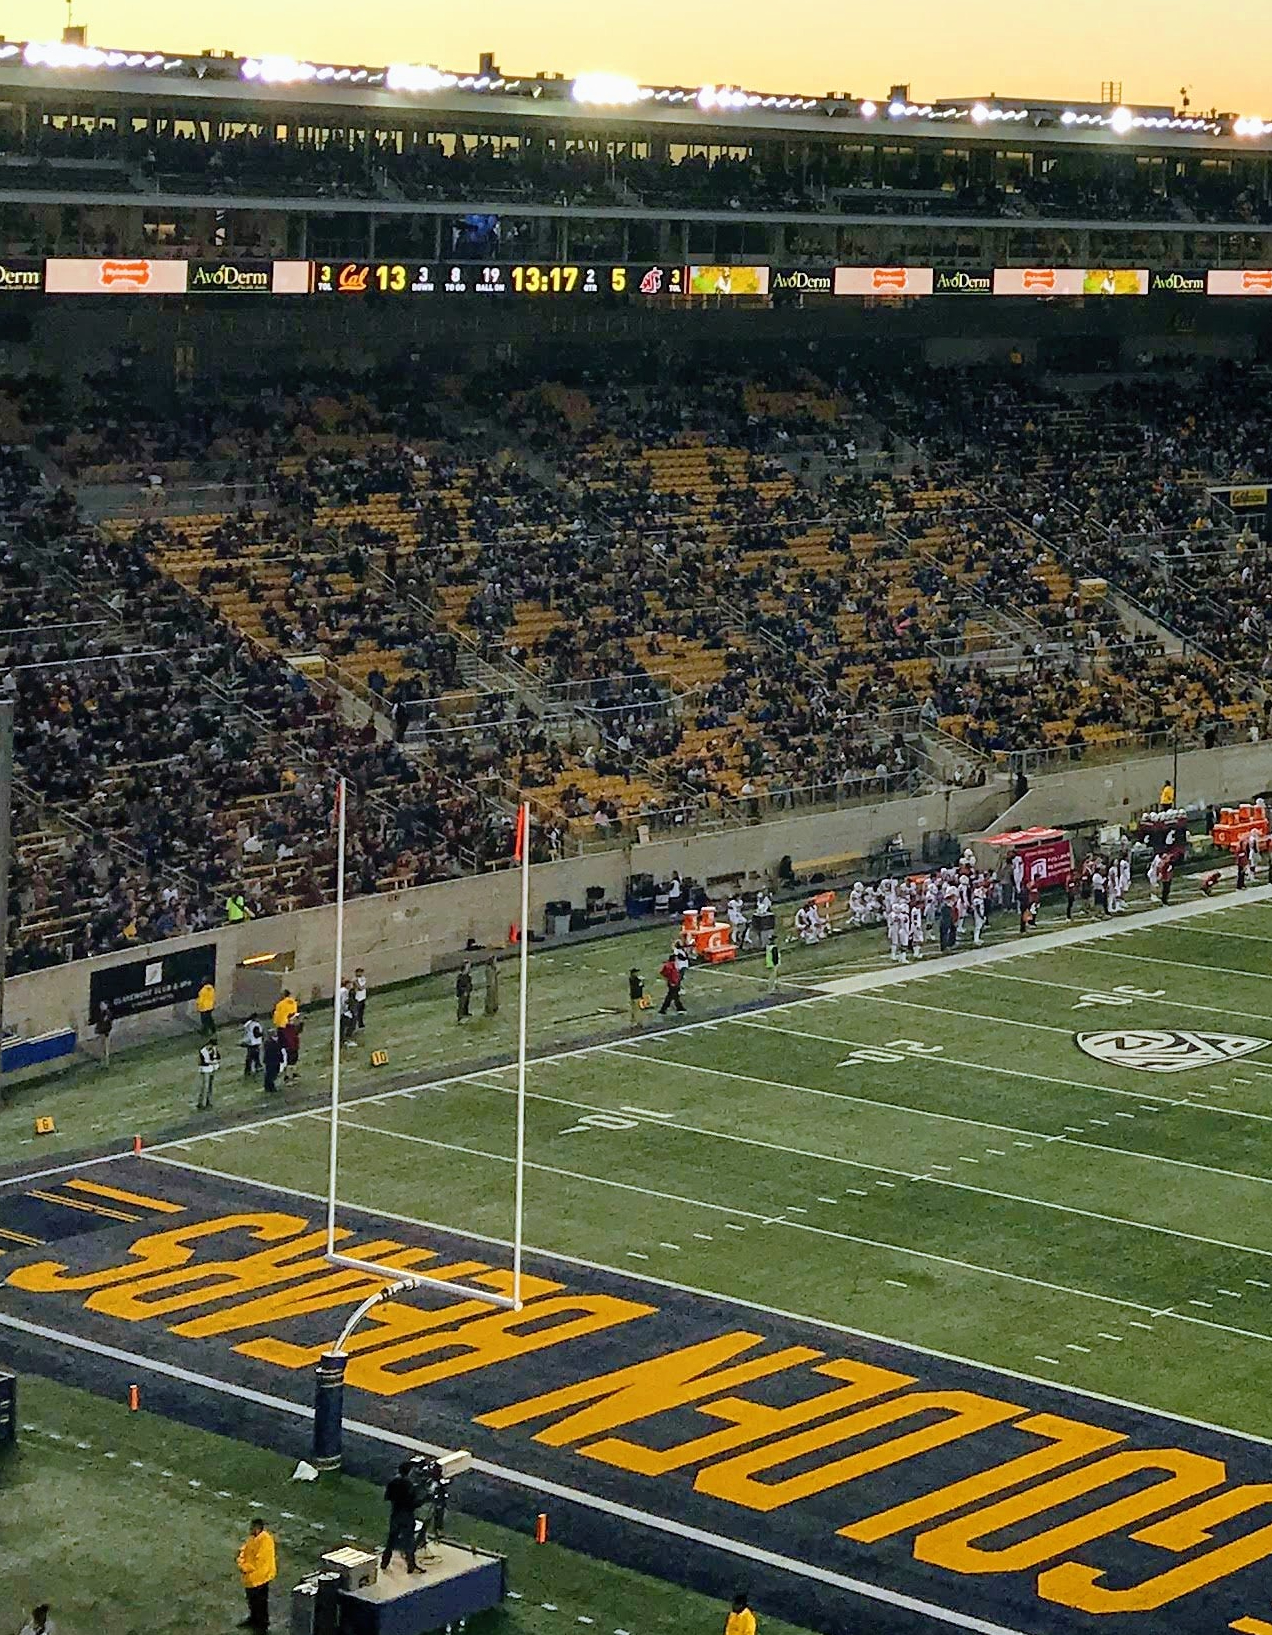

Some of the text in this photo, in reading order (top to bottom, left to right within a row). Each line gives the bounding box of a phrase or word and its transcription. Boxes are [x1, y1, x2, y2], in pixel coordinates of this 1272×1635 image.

[321, 266, 331, 281] 3
[338, 264, 369, 290] Cal
[376, 265, 406, 291] 13
[419, 267, 428, 282] 3
[483, 267, 500, 282] 19
[512, 267, 578, 292] 13:17
[586, 269, 595, 282] 2
[612, 268, 625, 291] 5
[671, 269, 680, 283] 3
